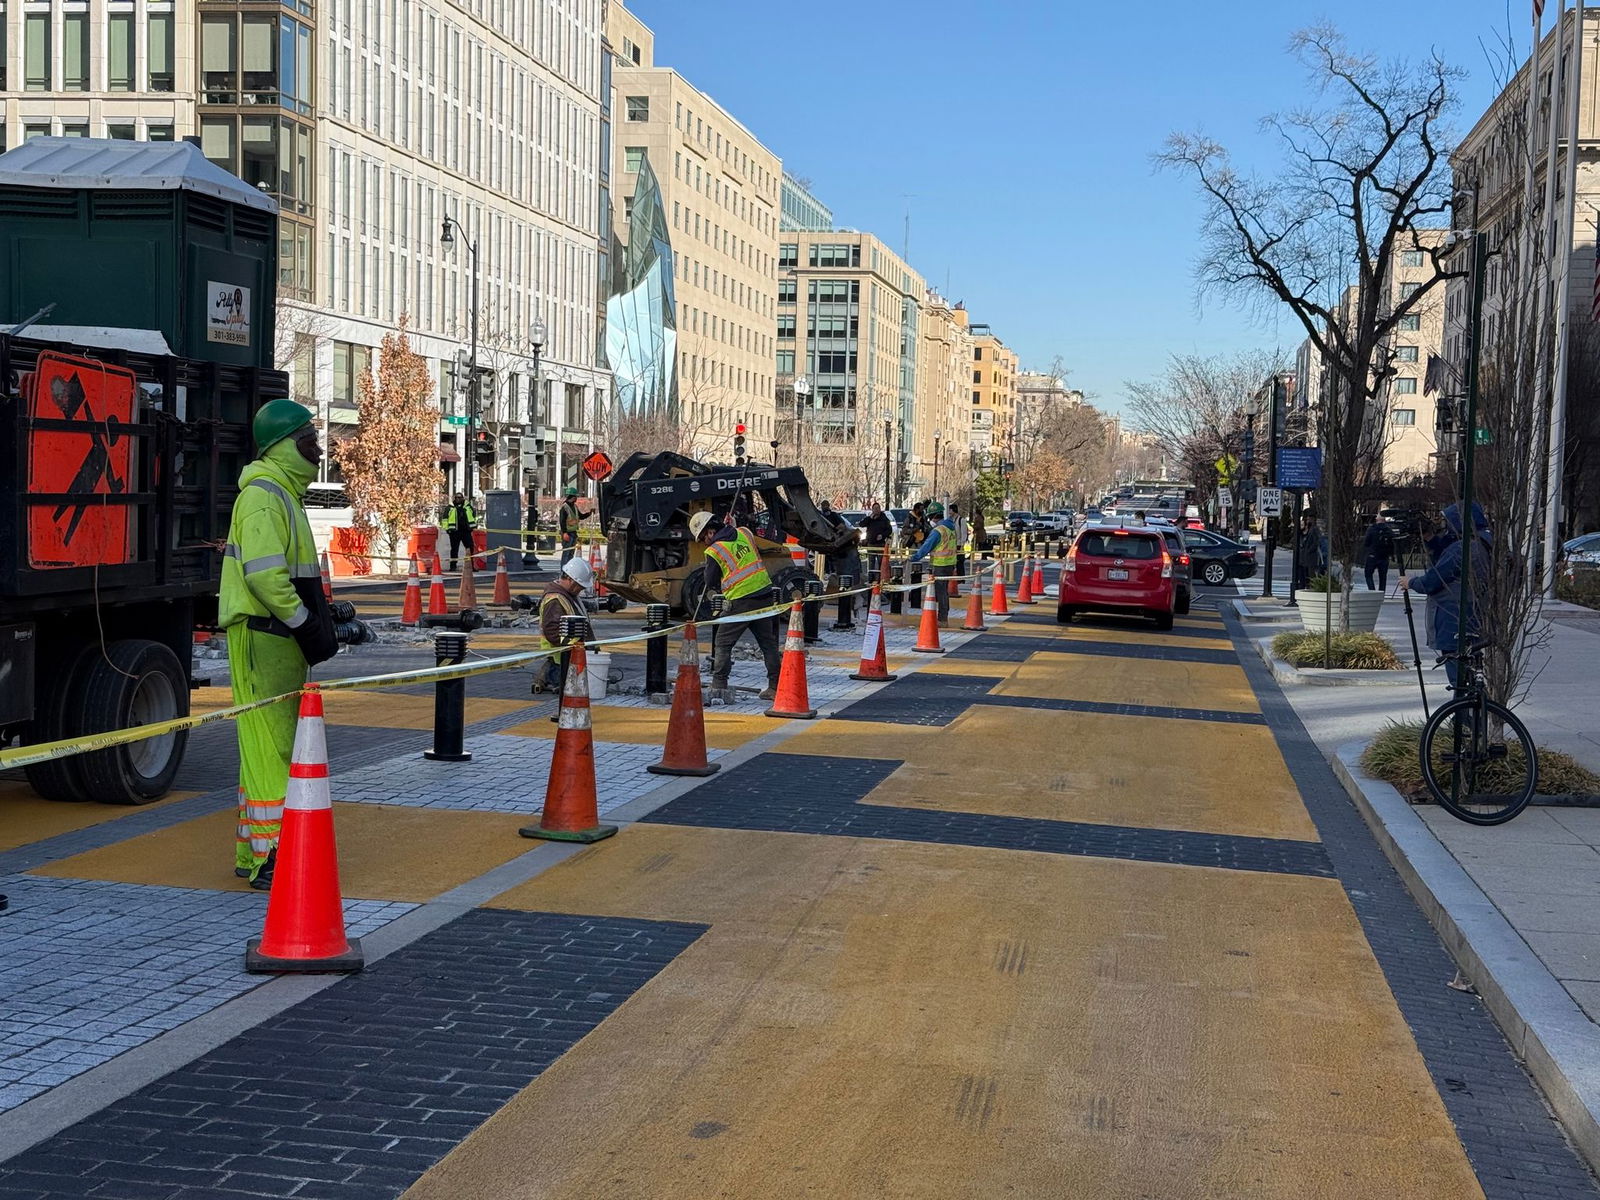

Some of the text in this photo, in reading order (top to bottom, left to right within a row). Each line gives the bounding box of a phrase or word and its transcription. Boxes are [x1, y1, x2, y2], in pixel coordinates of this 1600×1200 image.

[587, 461, 607, 472] SLOW
[717, 477, 762, 490] DEERE
[650, 485, 674, 494] 328E
[1262, 490, 1280, 498] ONE
